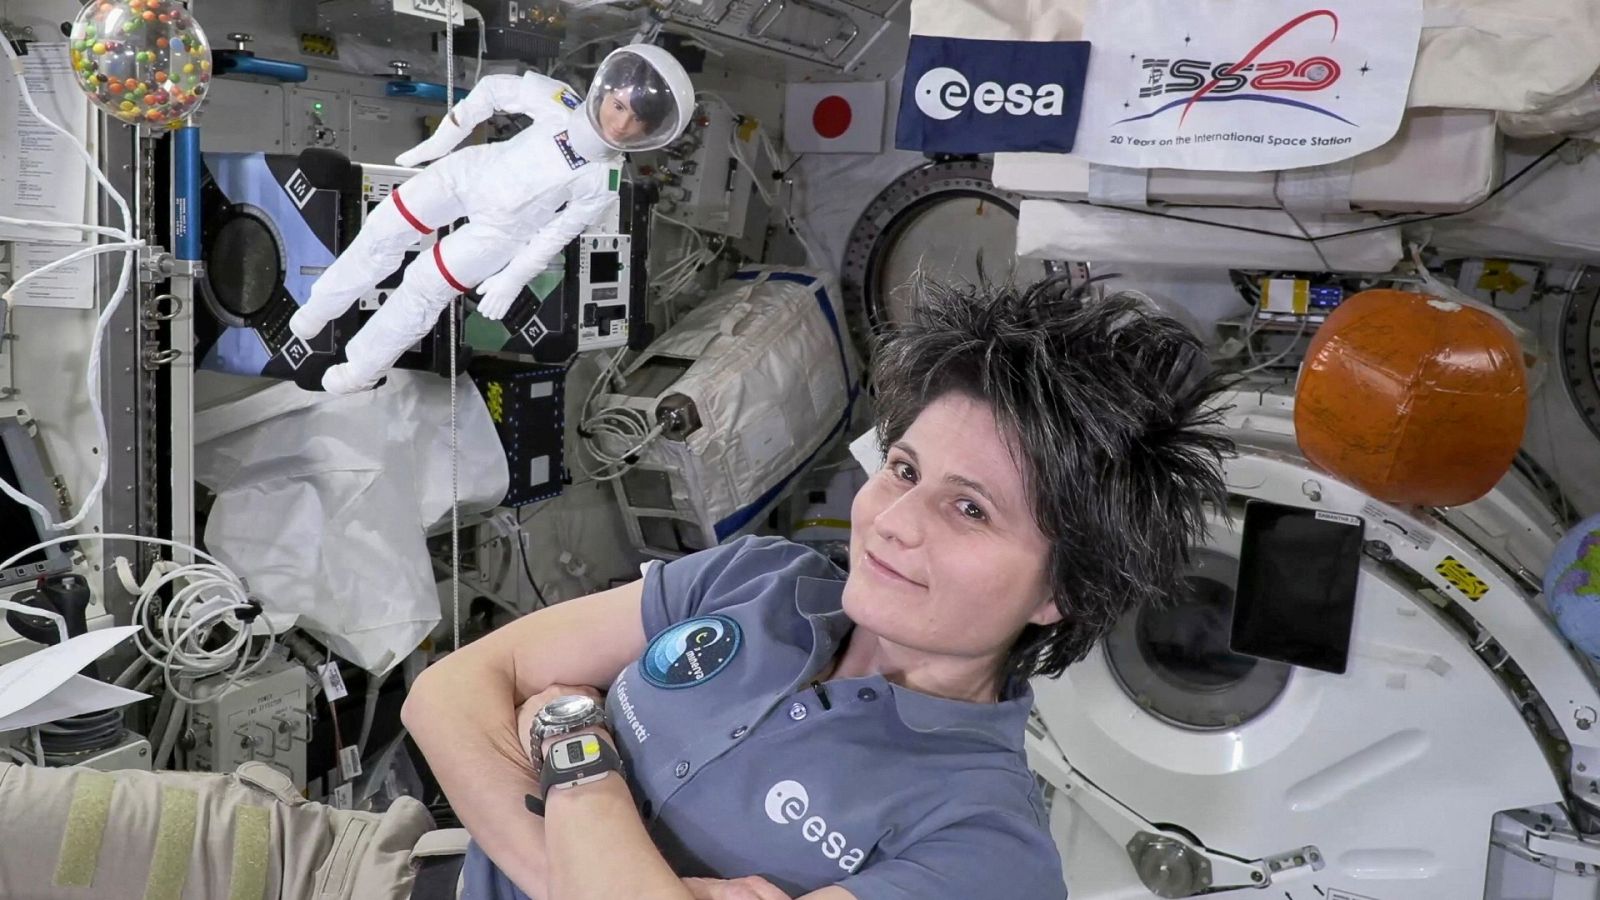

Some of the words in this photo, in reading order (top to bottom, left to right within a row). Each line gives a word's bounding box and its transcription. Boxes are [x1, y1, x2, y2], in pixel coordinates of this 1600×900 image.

[1110, 135, 1124, 145] 20
[1127, 136, 1156, 147] Years
[1159, 138, 1173, 146] on
[1175, 135, 1192, 145] the
[1194, 131, 1265, 144] International
[1267, 135, 1307, 147] Space
[1311, 136, 1352, 146] Station
[685, 650, 705, 681] minerva
